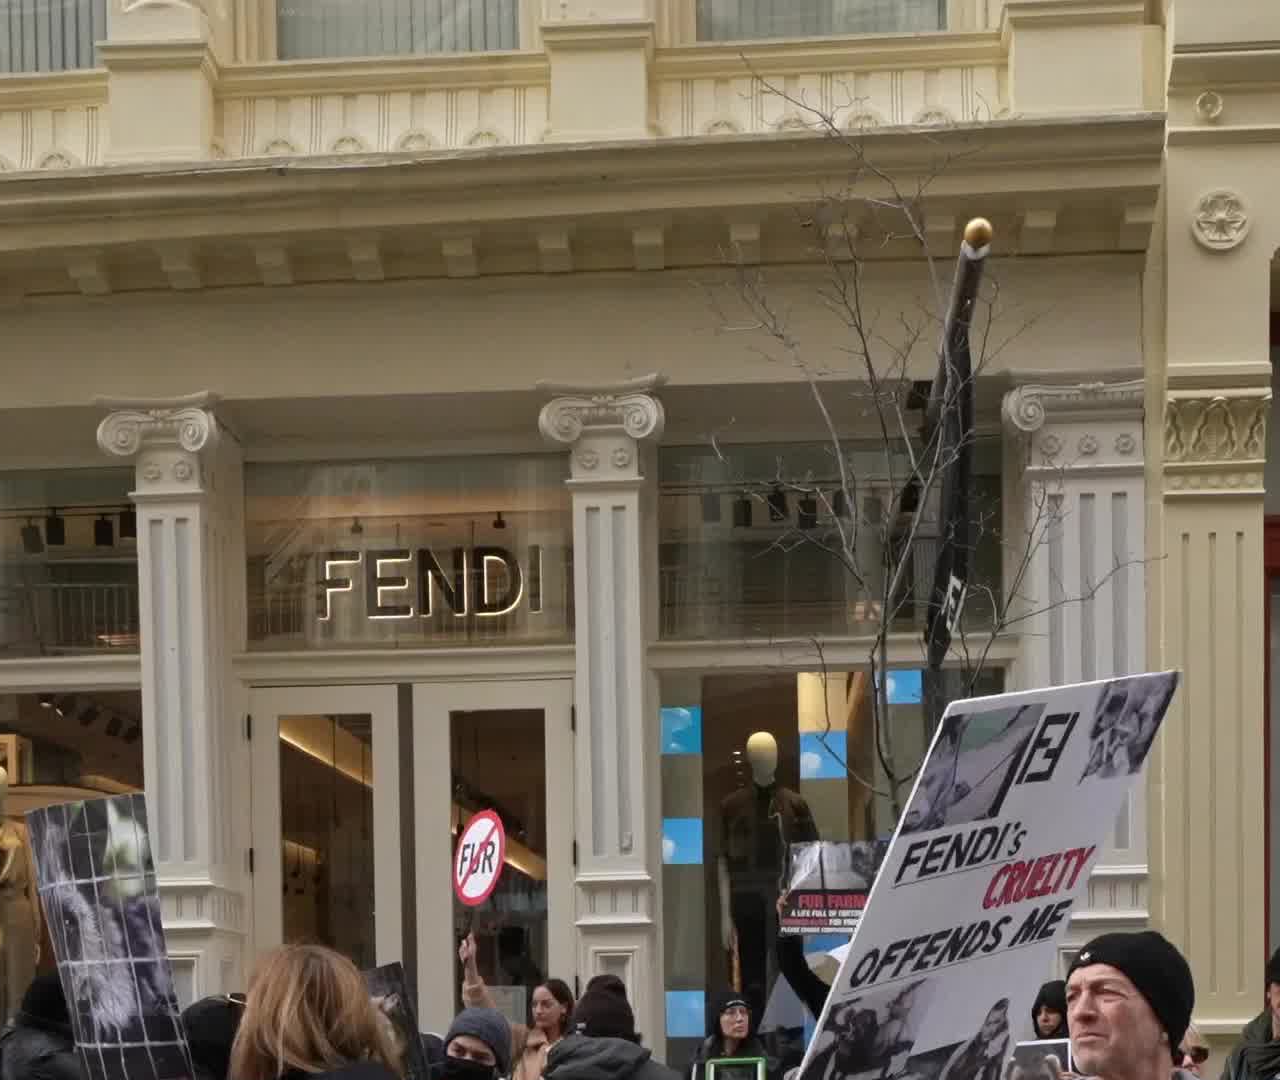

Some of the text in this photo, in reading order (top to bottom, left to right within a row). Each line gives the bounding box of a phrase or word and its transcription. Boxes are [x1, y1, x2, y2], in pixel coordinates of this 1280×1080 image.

[317, 546, 545, 621] FENDI
[459, 841, 496, 876] FUR
[981, 844, 1097, 911] CRUELTY
[849, 900, 1074, 988] OFFENDS ME
